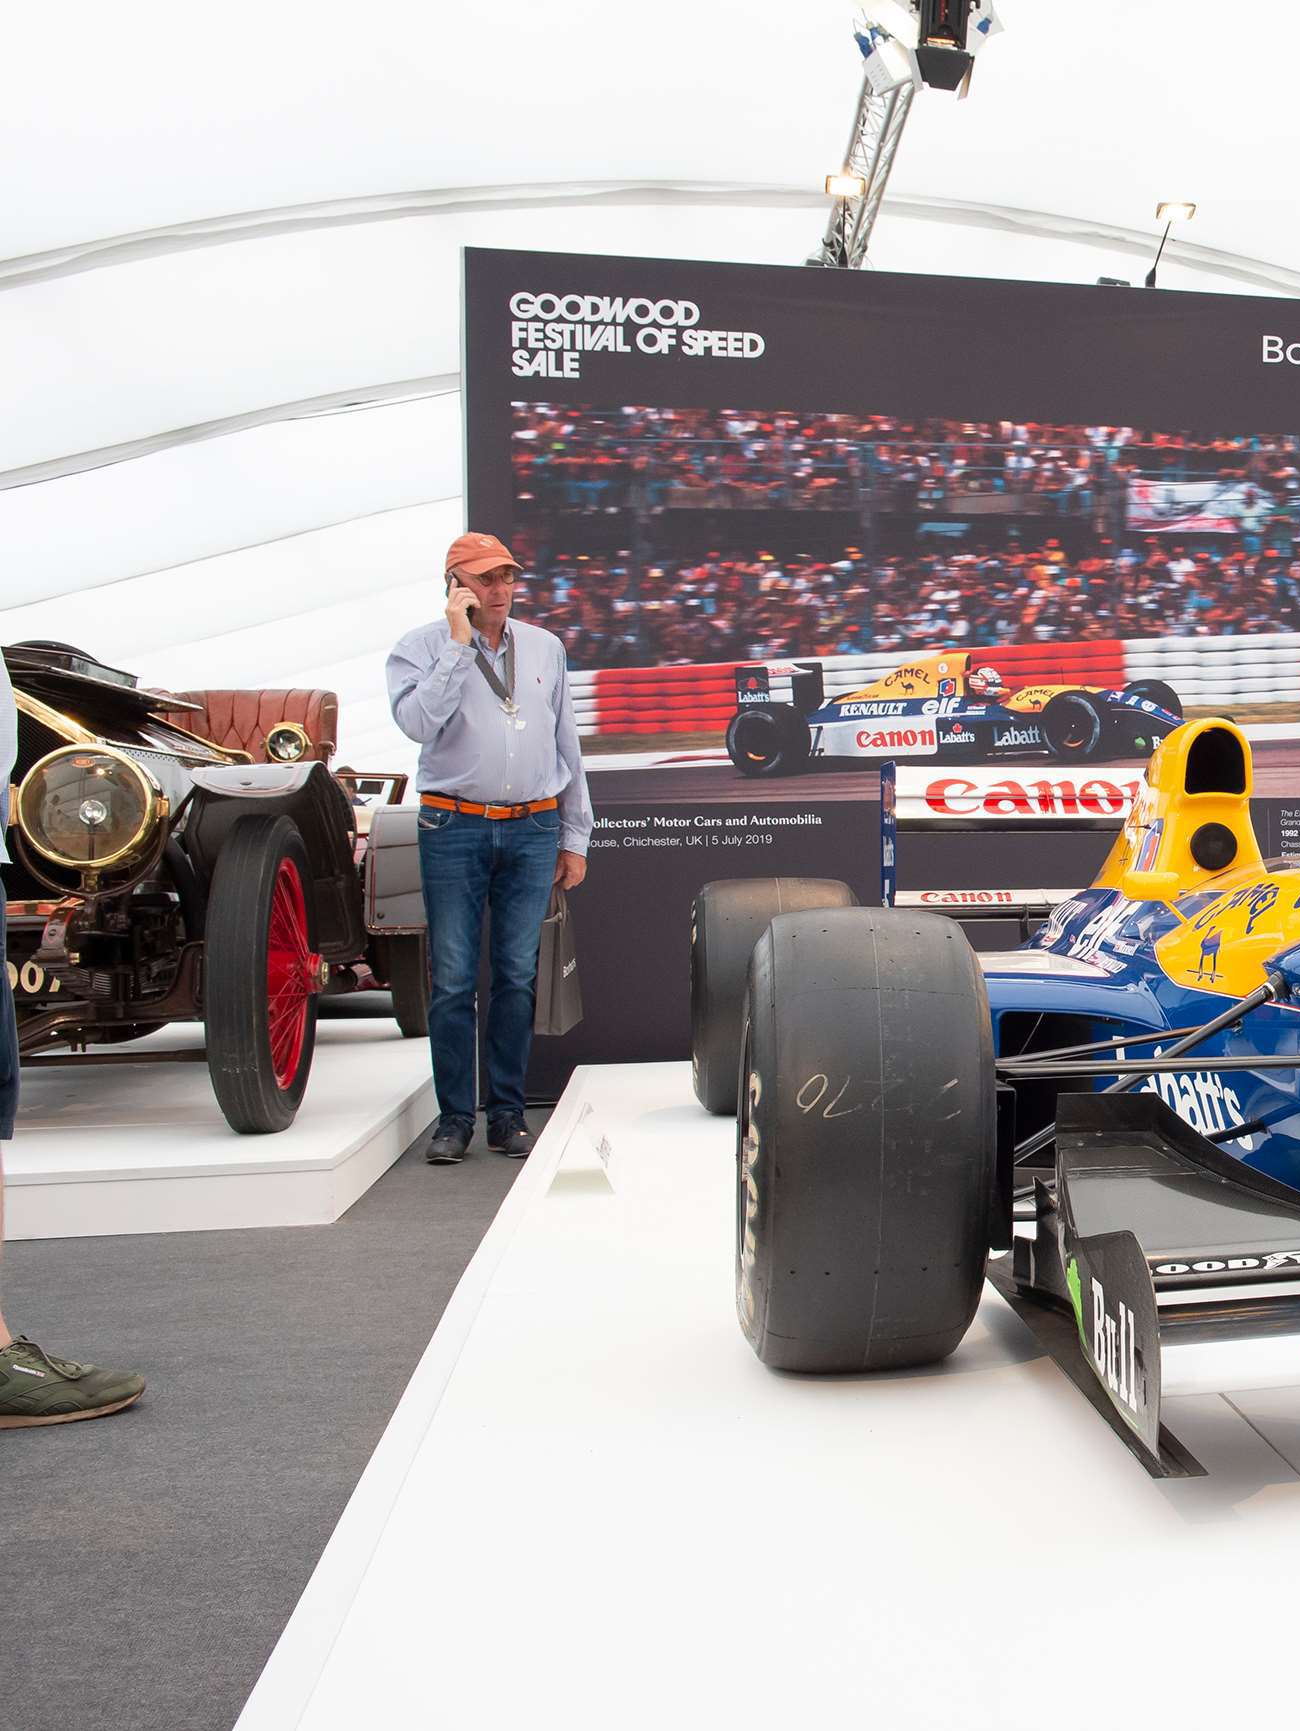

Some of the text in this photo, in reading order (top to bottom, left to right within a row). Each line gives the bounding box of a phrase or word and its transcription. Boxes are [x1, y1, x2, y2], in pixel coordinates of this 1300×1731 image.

[509, 291, 700, 327] GOODWOOD
[512, 321, 765, 359] FESTIVAL OF SPEED
[512, 350, 580, 379] SALE
[884, 667, 931, 687] CAMEL
[840, 702, 907, 717] RENAULT
[922, 696, 962, 715] elf
[856, 729, 935, 749] Canon
[593, 814, 823, 829] ollectors' Motor Cars and Automobilia
[590, 839, 620, 849] ouse,
[623, 836, 683, 848] Chichester,
[686, 835, 703, 846] UK
[712, 834, 719, 846] 5
[722, 834, 743, 847] July
[745, 833, 773, 845] 2019
[1281, 829, 1299, 837] 1992
[920, 889, 1014, 904] Canon
[1091, 1276, 1138, 1414] Bull
